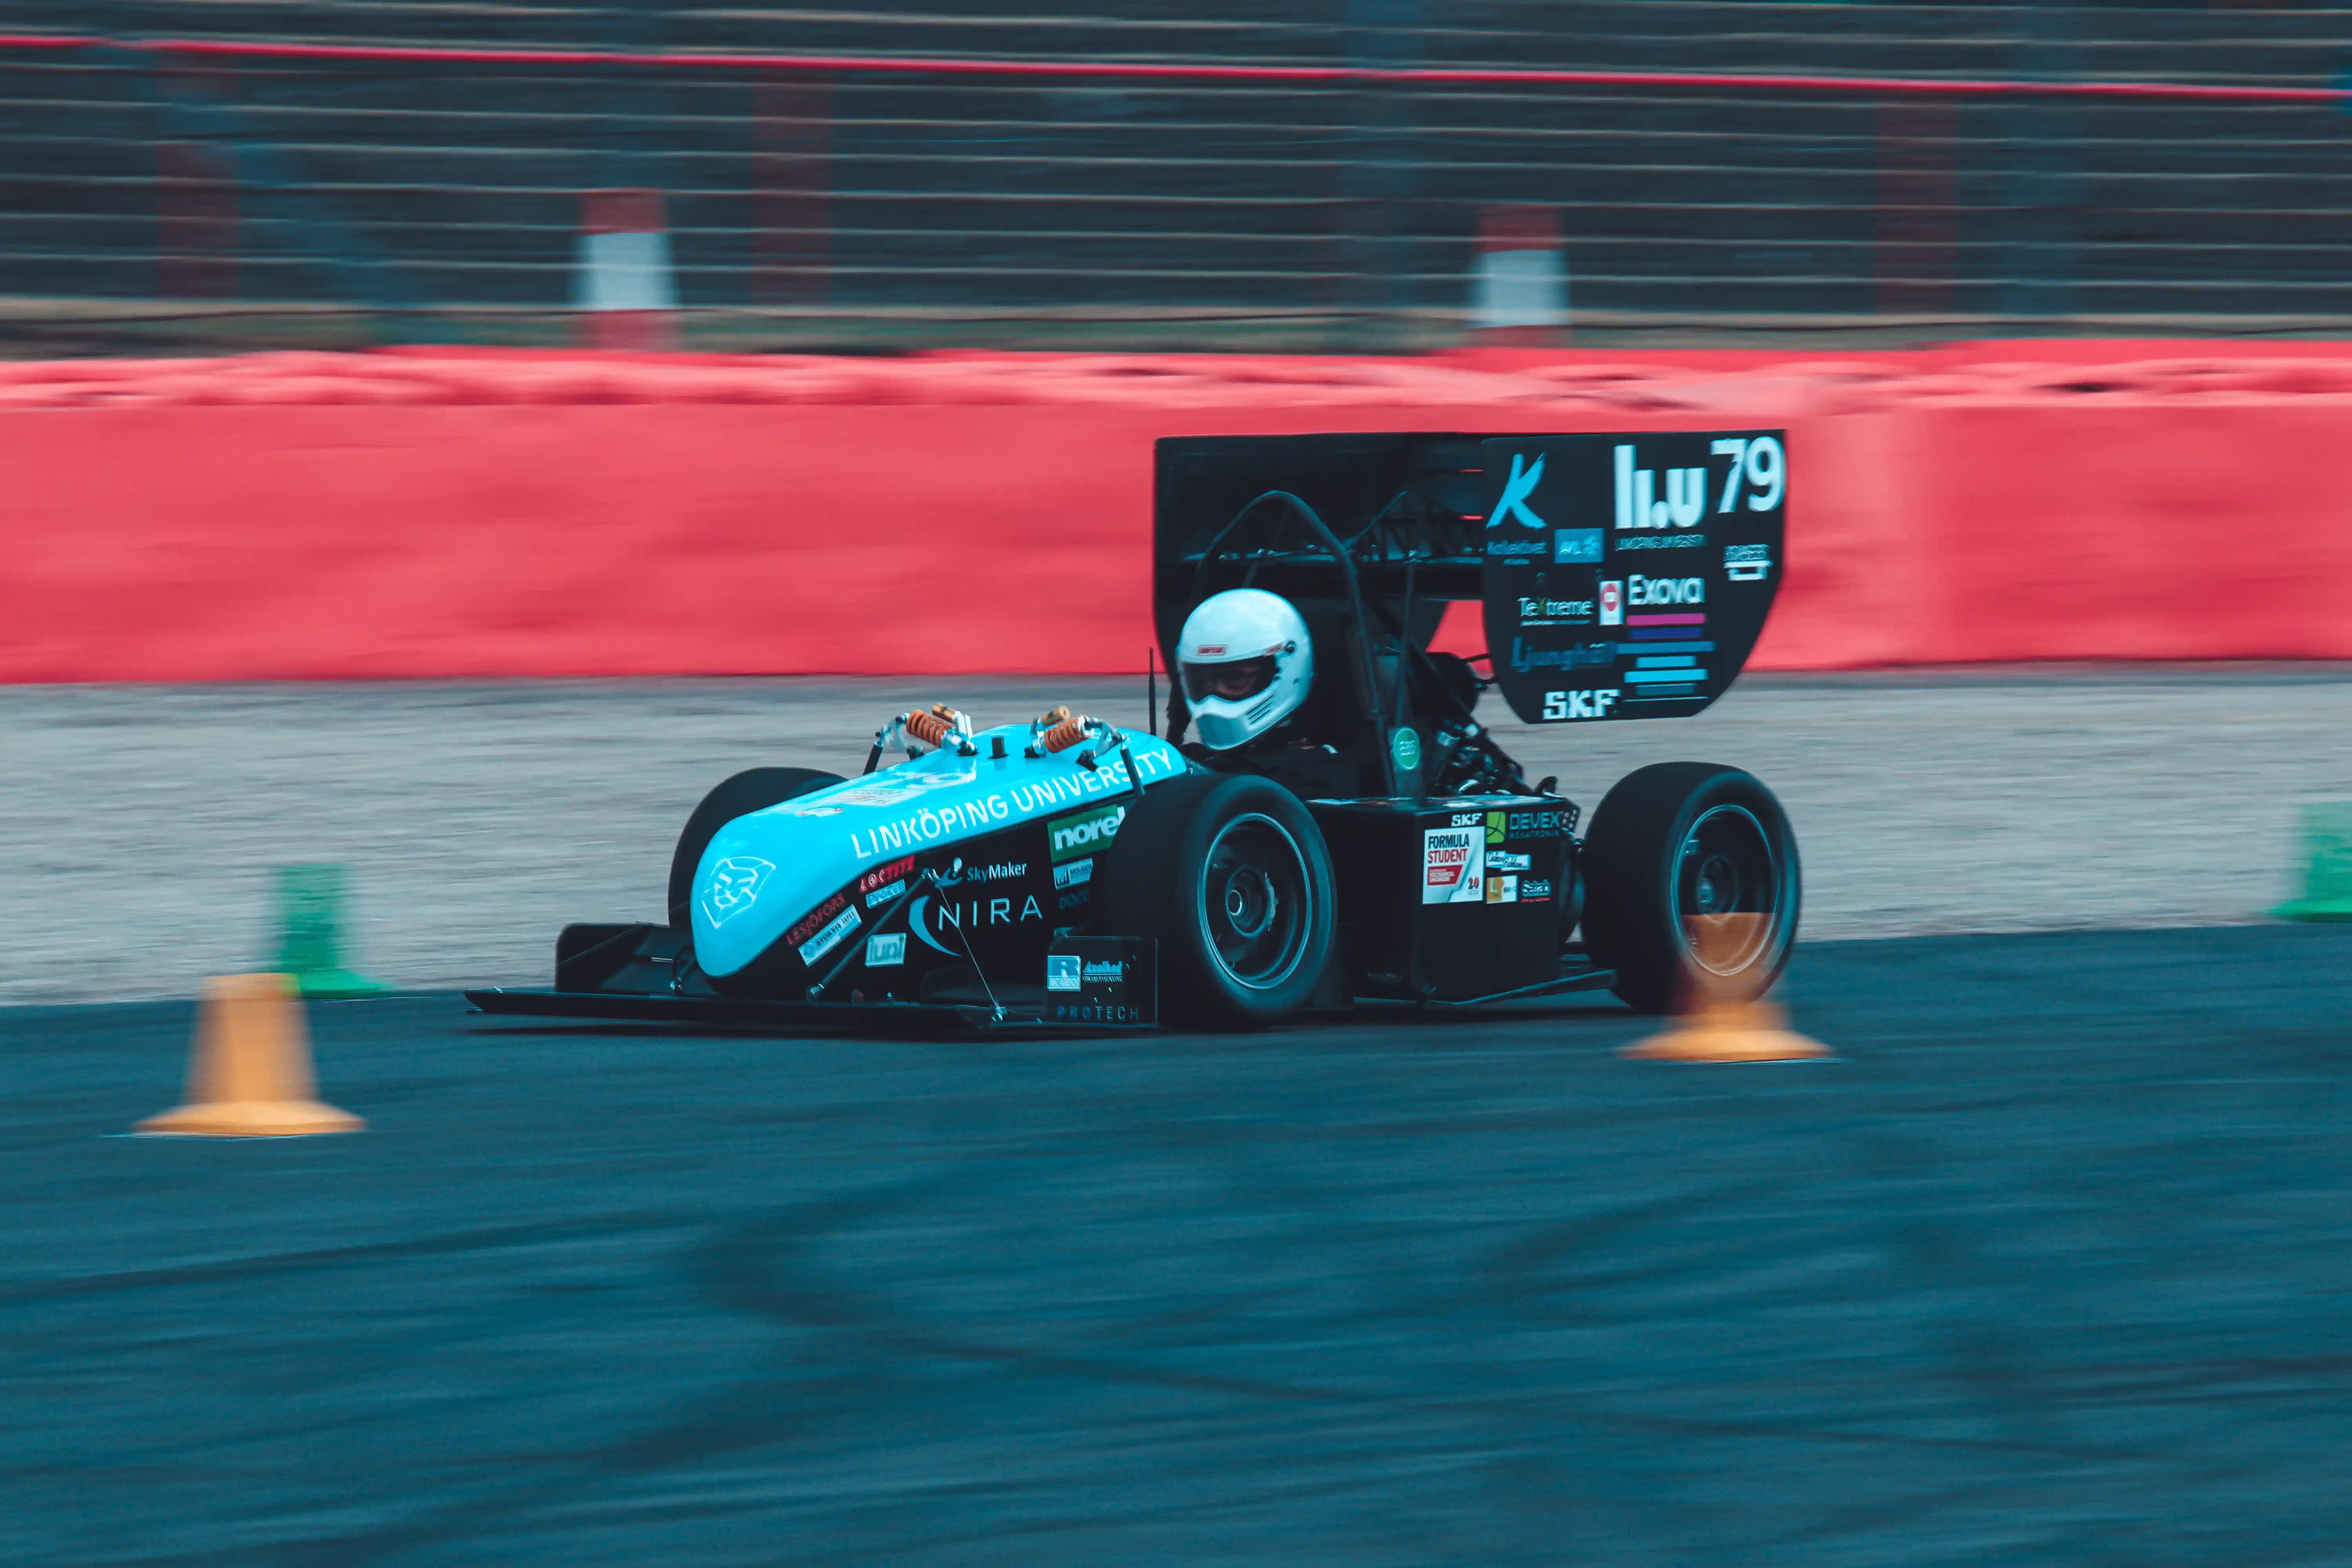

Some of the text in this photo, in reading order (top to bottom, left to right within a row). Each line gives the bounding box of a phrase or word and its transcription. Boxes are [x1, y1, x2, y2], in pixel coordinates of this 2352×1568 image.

[1710, 436, 1786, 513] 79
[1628, 574, 1705, 605] Exova
[1543, 689, 1621, 720] SKF
[851, 794, 1009, 858] LINKÖPING
[1451, 813, 1483, 826] SKF
[1510, 811, 1561, 830] DEVEX
[1428, 834, 1469, 849] FORMULA
[1427, 848, 1468, 864] STUDENT
[859, 855, 915, 893] LOCTITE
[967, 861, 1027, 882] SkyMaker
[938, 895, 1043, 931] NIRA
[1057, 1005, 1138, 1021] PROTECH
